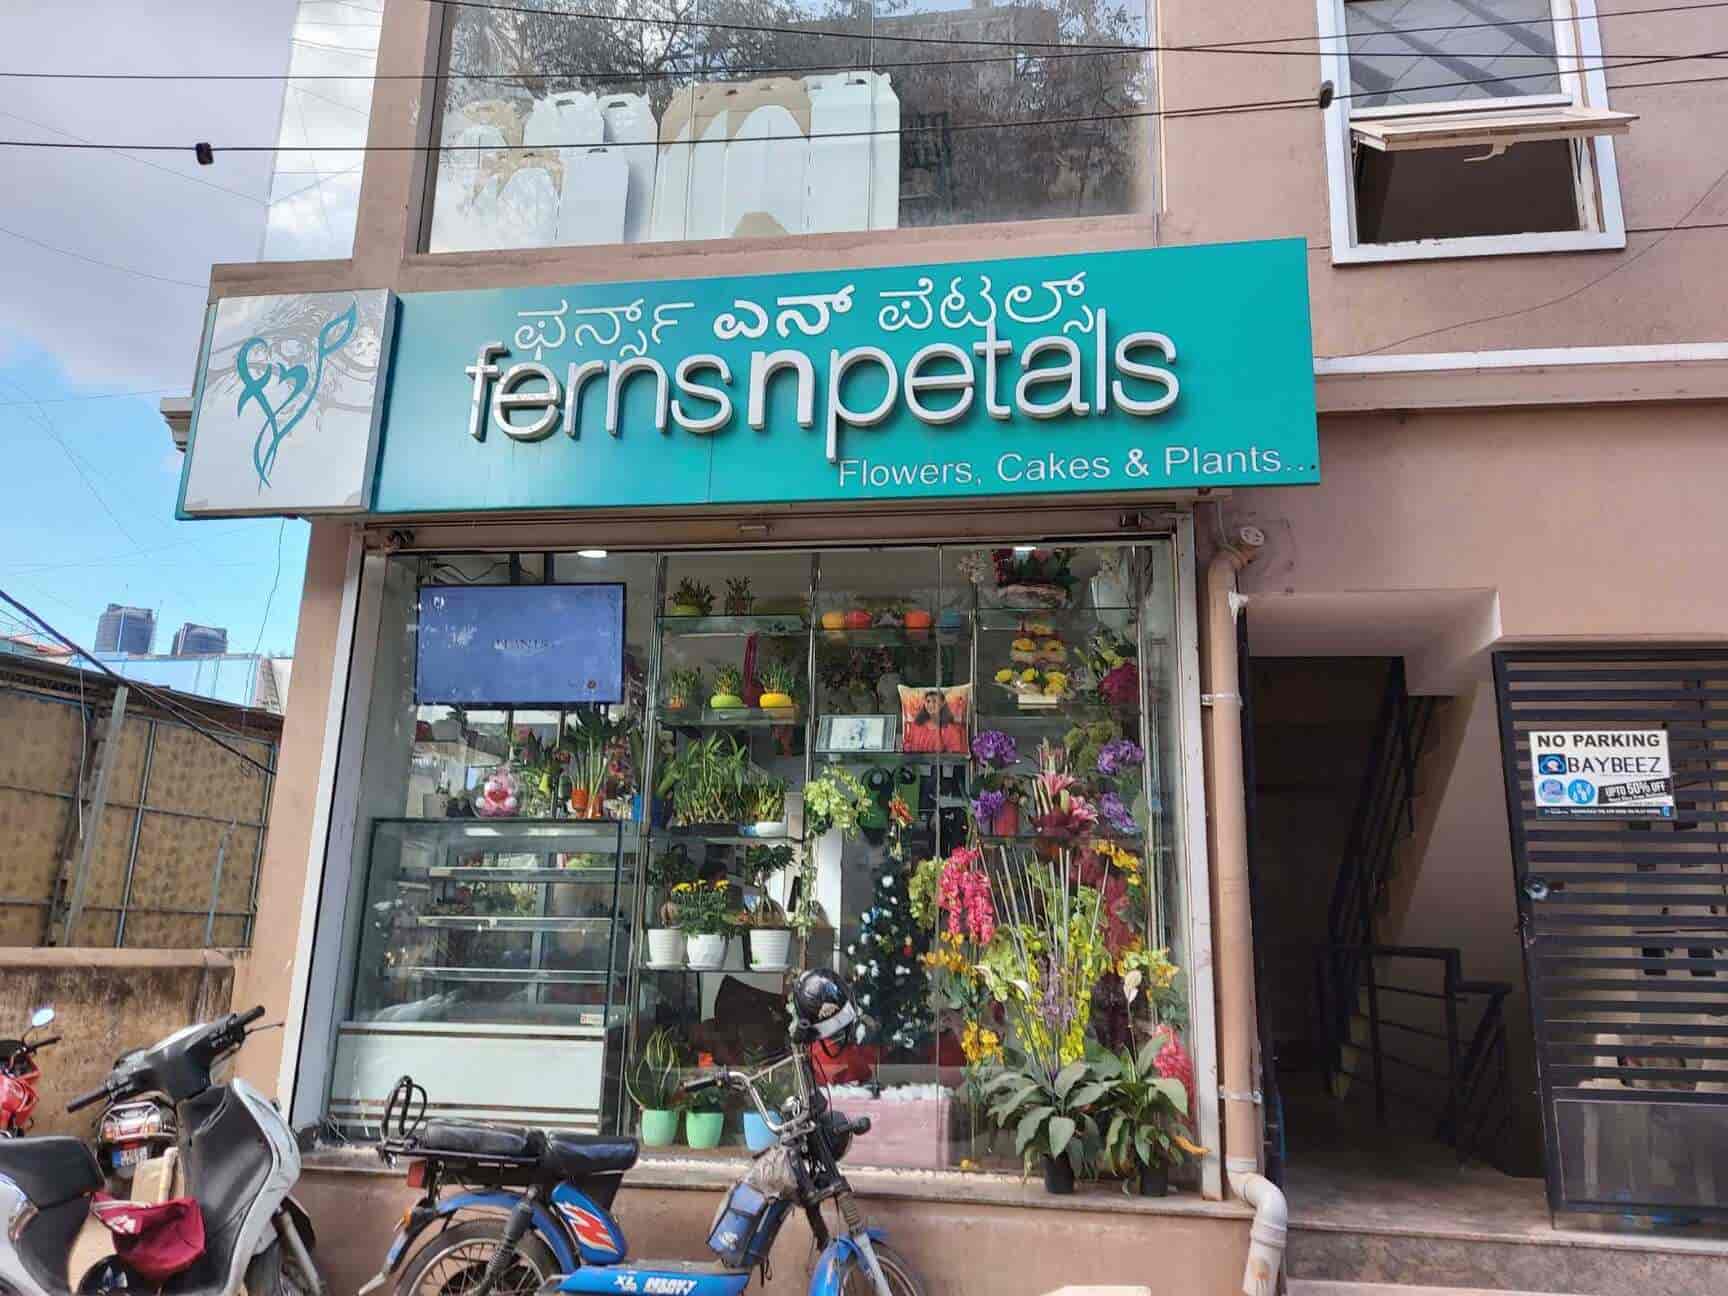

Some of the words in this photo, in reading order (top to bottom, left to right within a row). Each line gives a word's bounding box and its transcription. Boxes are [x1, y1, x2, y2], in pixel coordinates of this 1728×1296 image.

[713, 284, 855, 340] ಎನ್
[839, 458, 982, 489] Flowers,
[997, 453, 1111, 482] Cakes
[1124, 448, 1150, 477] &
[1537, 734, 1566, 748] NO
[1573, 733, 1660, 748] PARKING
[1567, 756, 1663, 773] BAYBEEZ
[1626, 781, 1651, 795] 50%
